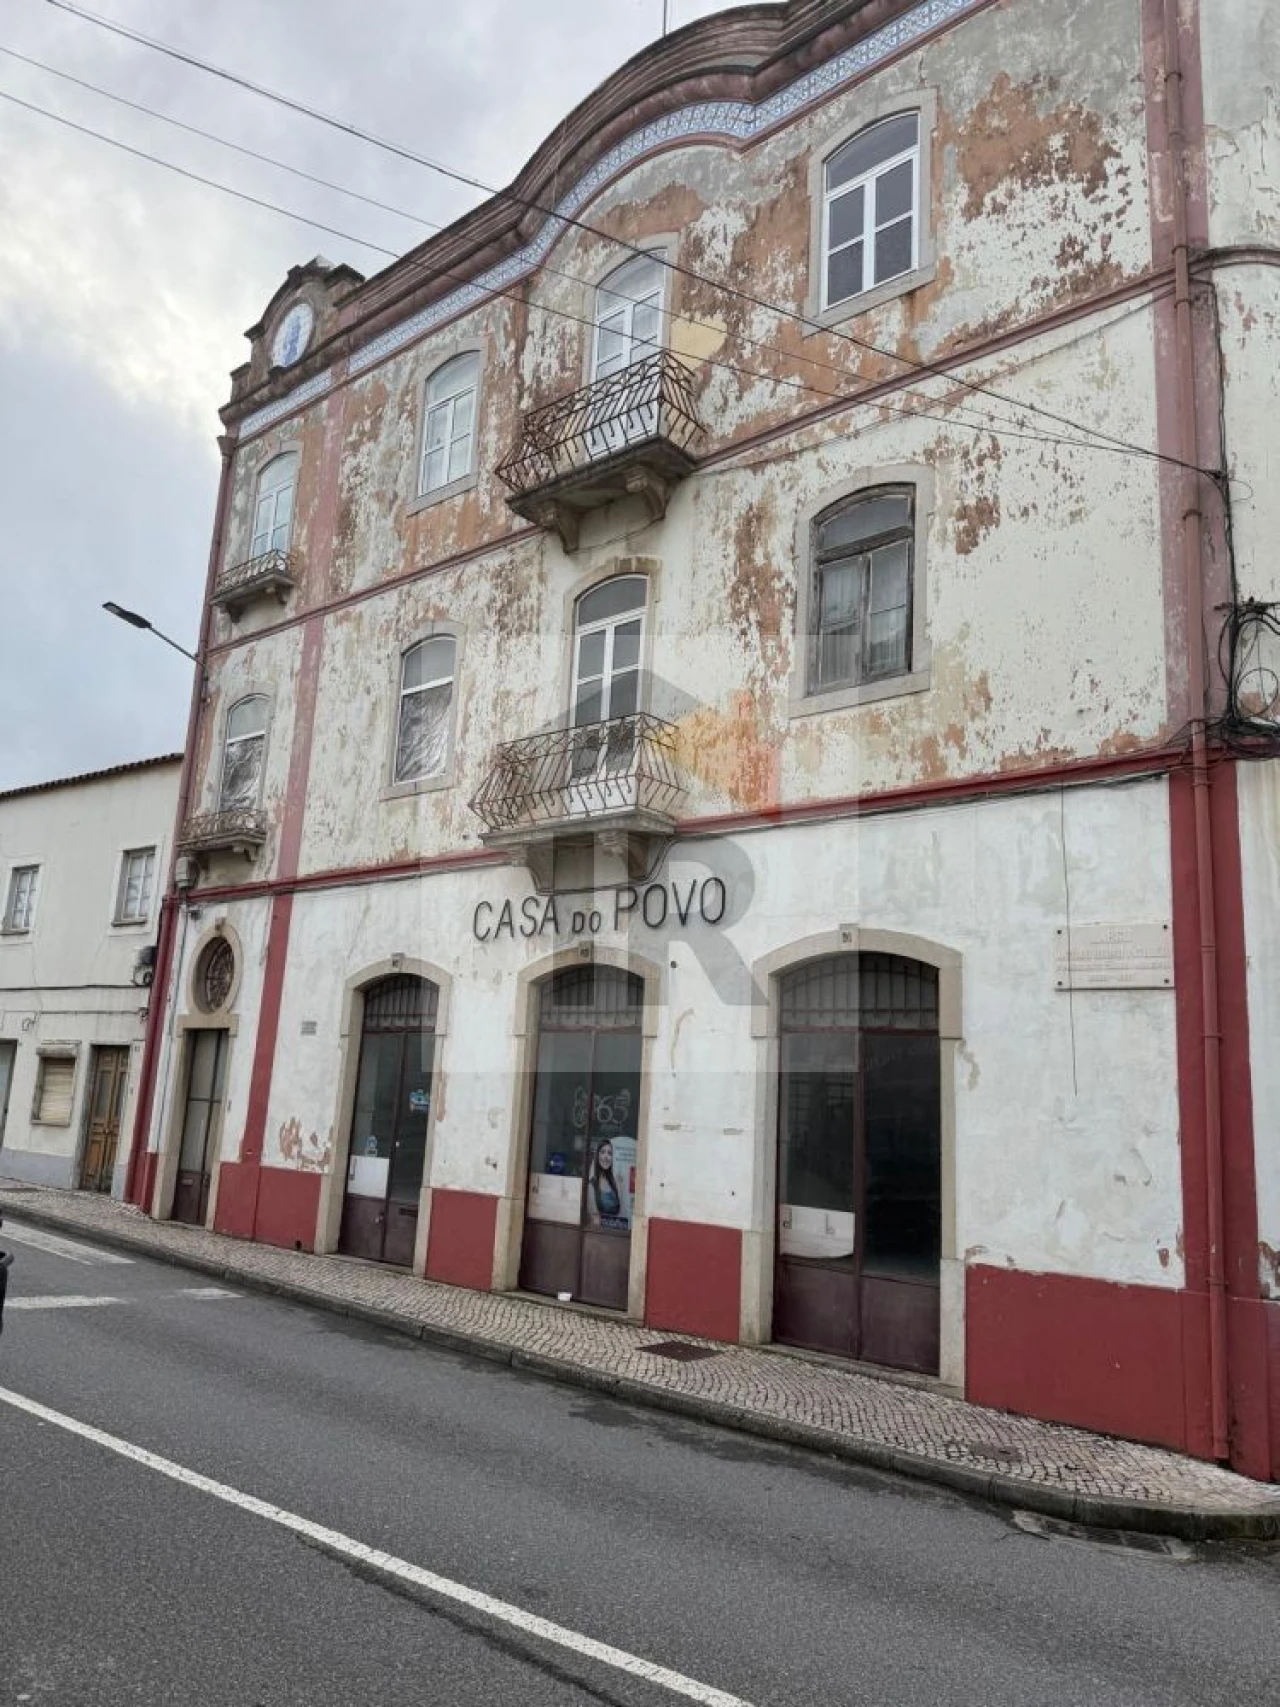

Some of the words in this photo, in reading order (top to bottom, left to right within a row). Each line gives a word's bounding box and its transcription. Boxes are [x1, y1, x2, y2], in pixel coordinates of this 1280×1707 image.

[473, 895, 560, 942] CASA
[571, 910, 602, 934] DO
[613, 876, 727, 931] POVO
